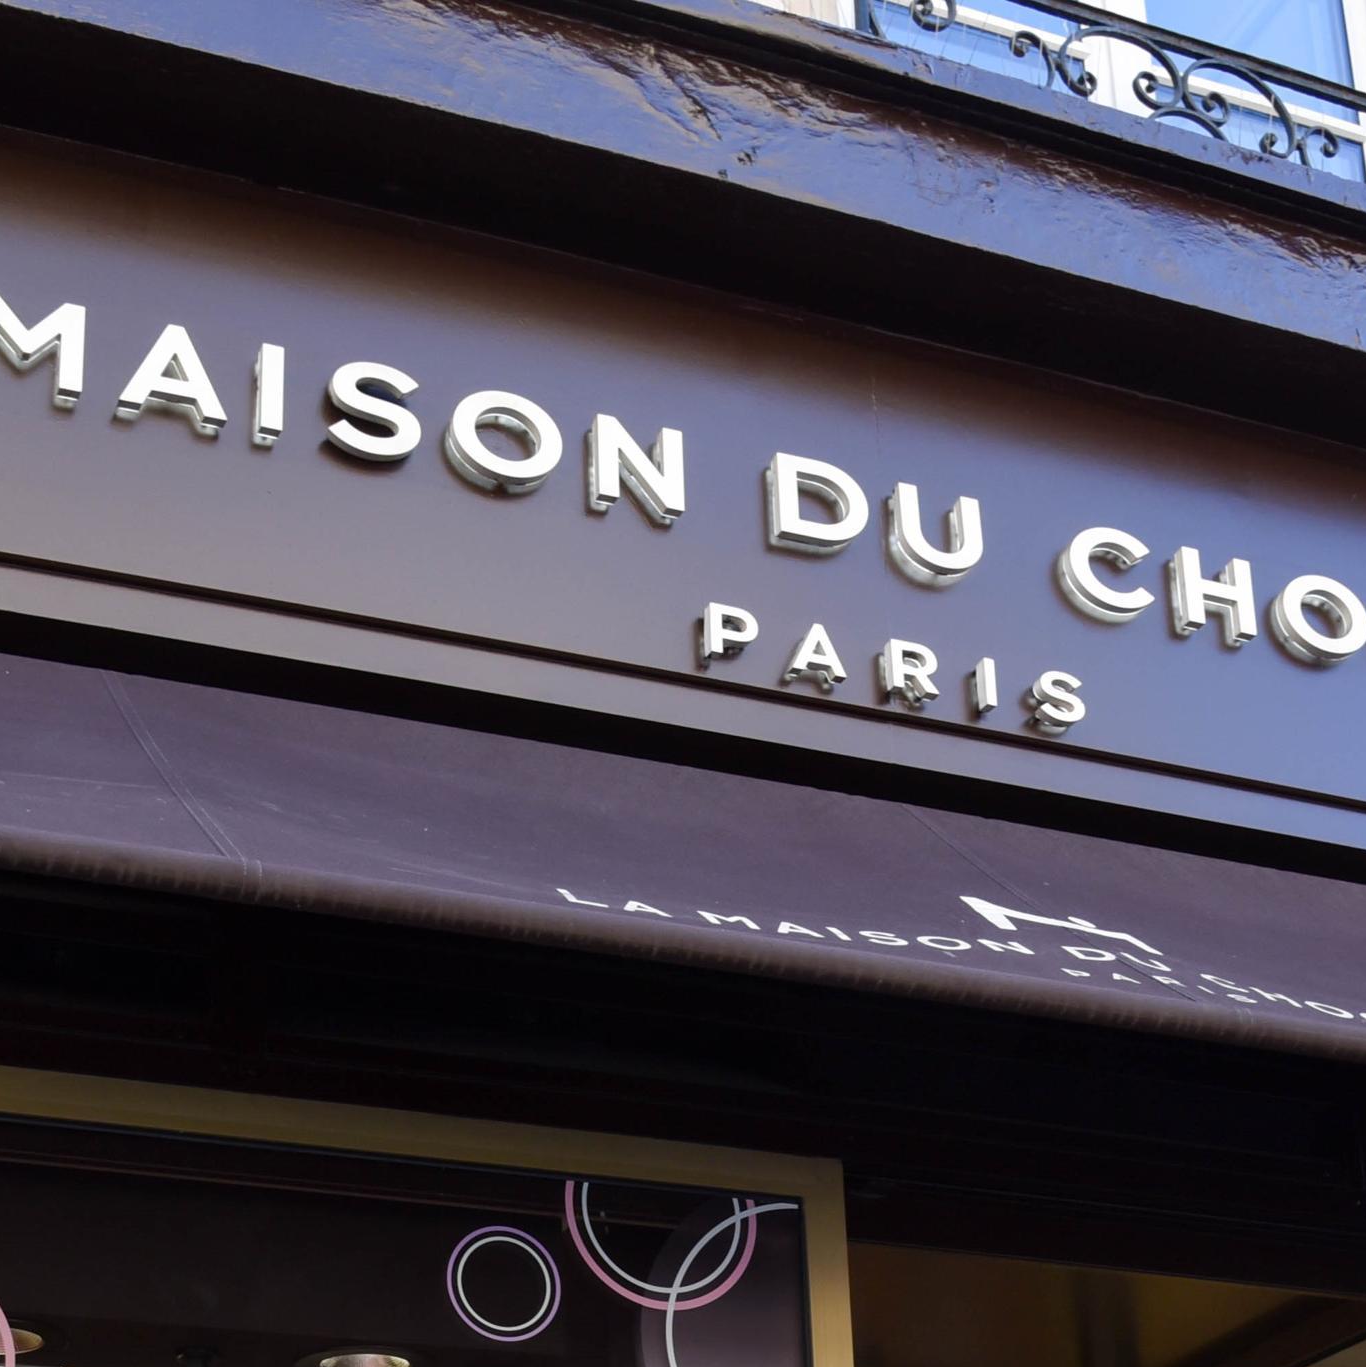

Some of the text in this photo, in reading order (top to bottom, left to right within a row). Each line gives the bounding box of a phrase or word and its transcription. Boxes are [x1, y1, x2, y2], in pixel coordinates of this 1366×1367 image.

[765, 451, 985, 588] DU
[698, 601, 1087, 736] PARIS
[555, 887, 674, 918] LA
[697, 910, 1035, 955] MAISON
[1061, 945, 1172, 972] DU
[1061, 968, 1258, 1004] PARIS
